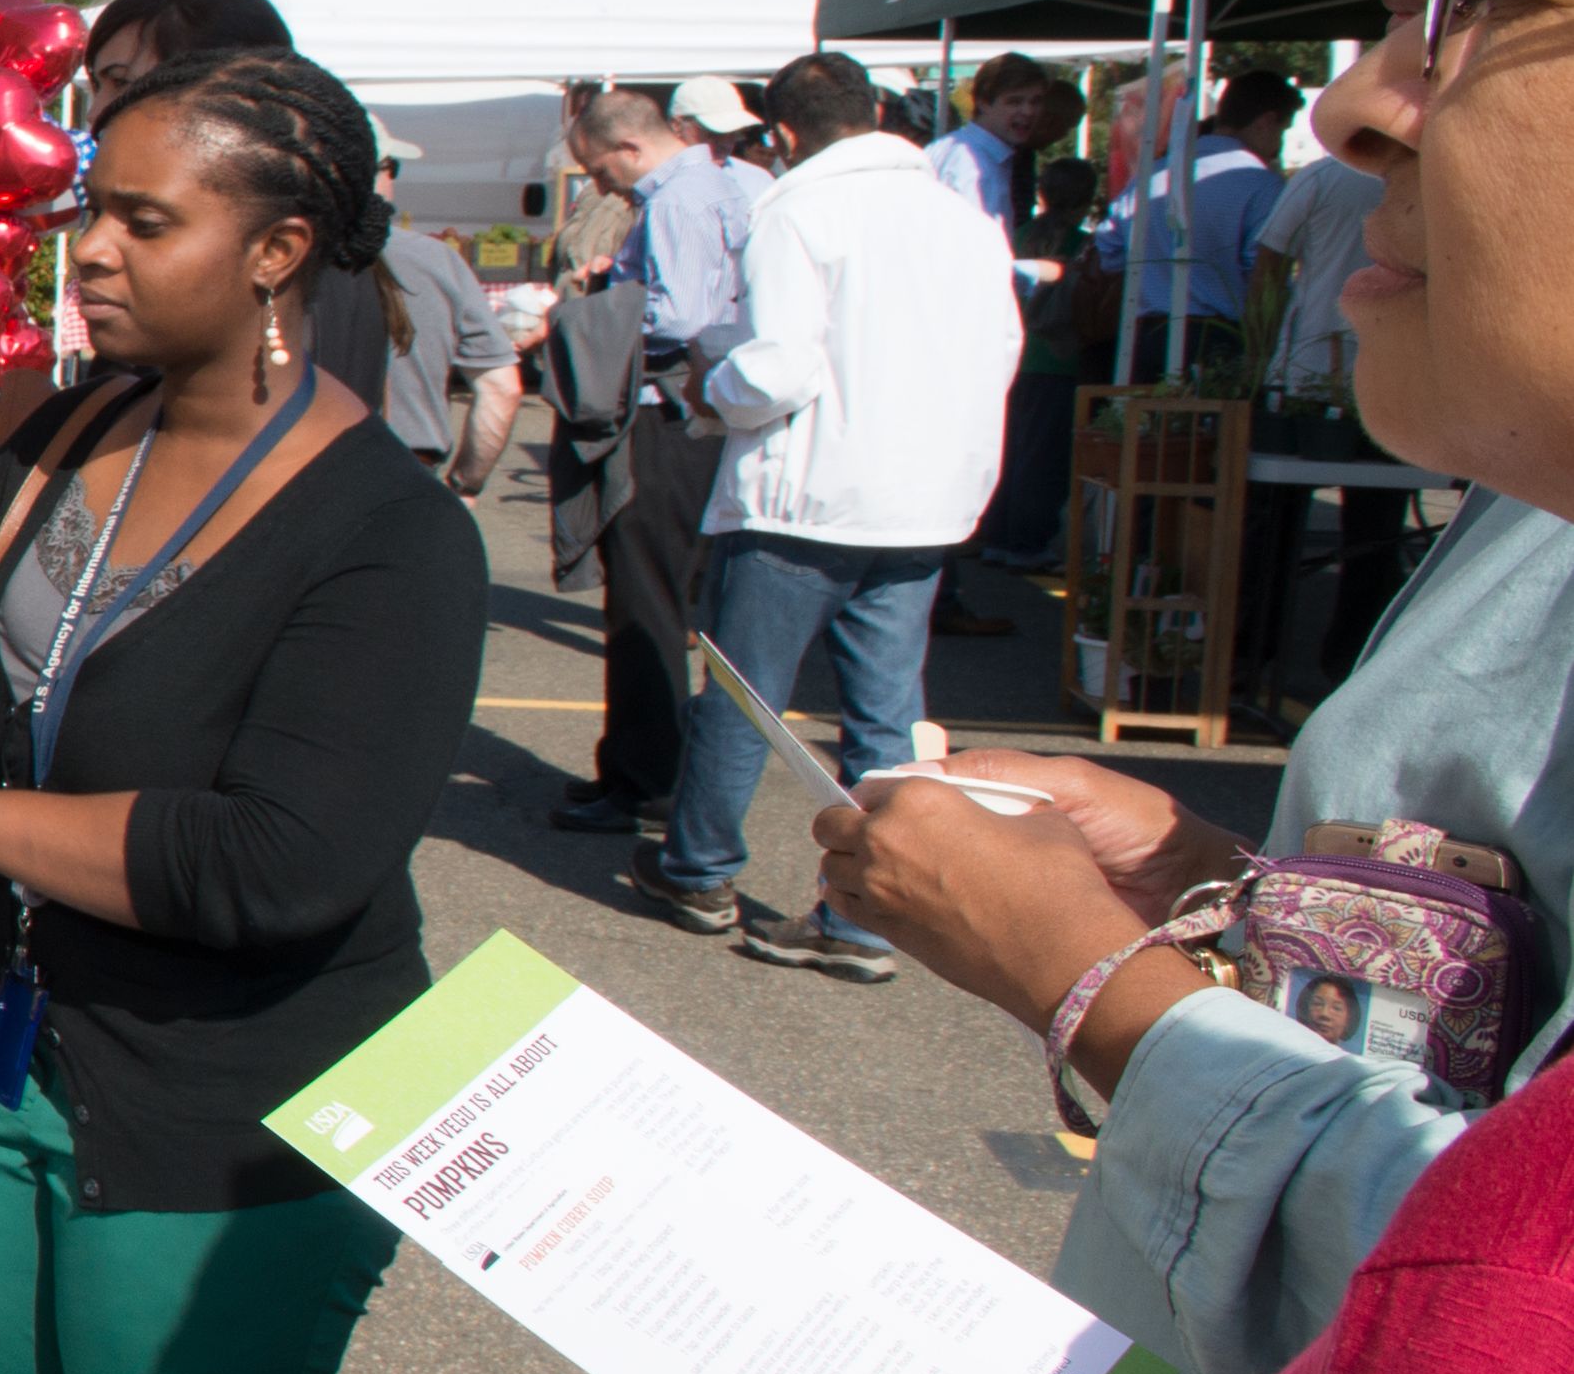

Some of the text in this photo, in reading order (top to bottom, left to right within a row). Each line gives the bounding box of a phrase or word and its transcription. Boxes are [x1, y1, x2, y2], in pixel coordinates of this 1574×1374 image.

[32, 515, 118, 715] U.S. Agency for International
[304, 1100, 354, 1135] USDA
[373, 1033, 559, 1191] THIS WEEK VEGU IS ALL ABOUT
[402, 1131, 510, 1221] PUMPKINS
[518, 1175, 617, 1273] PUMPKIN CURRY SOUP
